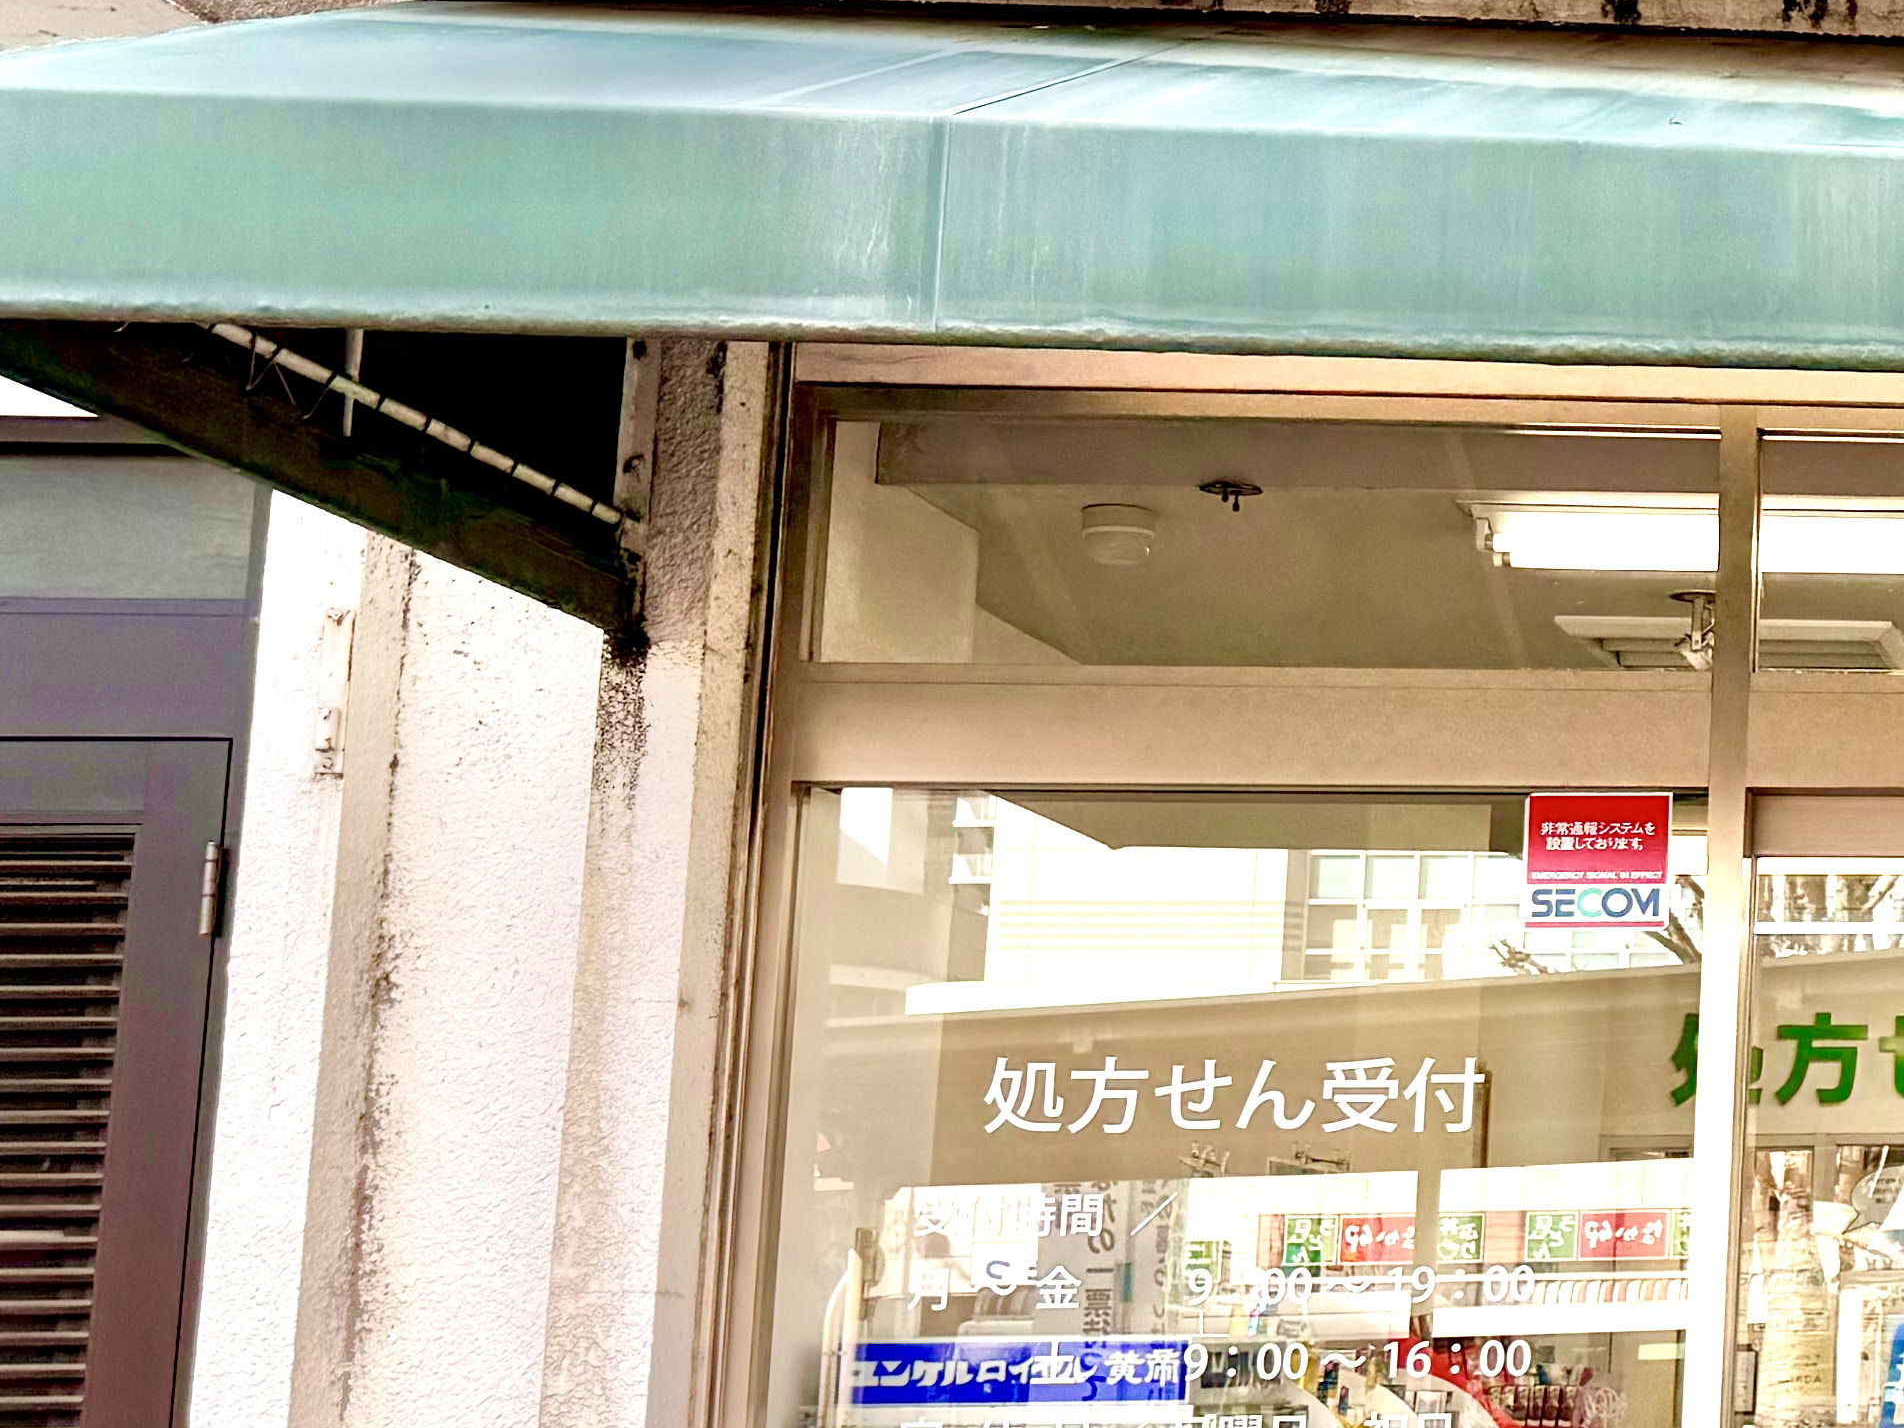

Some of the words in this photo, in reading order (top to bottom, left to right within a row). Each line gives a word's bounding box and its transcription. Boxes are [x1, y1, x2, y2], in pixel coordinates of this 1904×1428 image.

[1531, 888, 1660, 918] SECOM
[983, 1056, 1485, 1134] 処方せん受付
